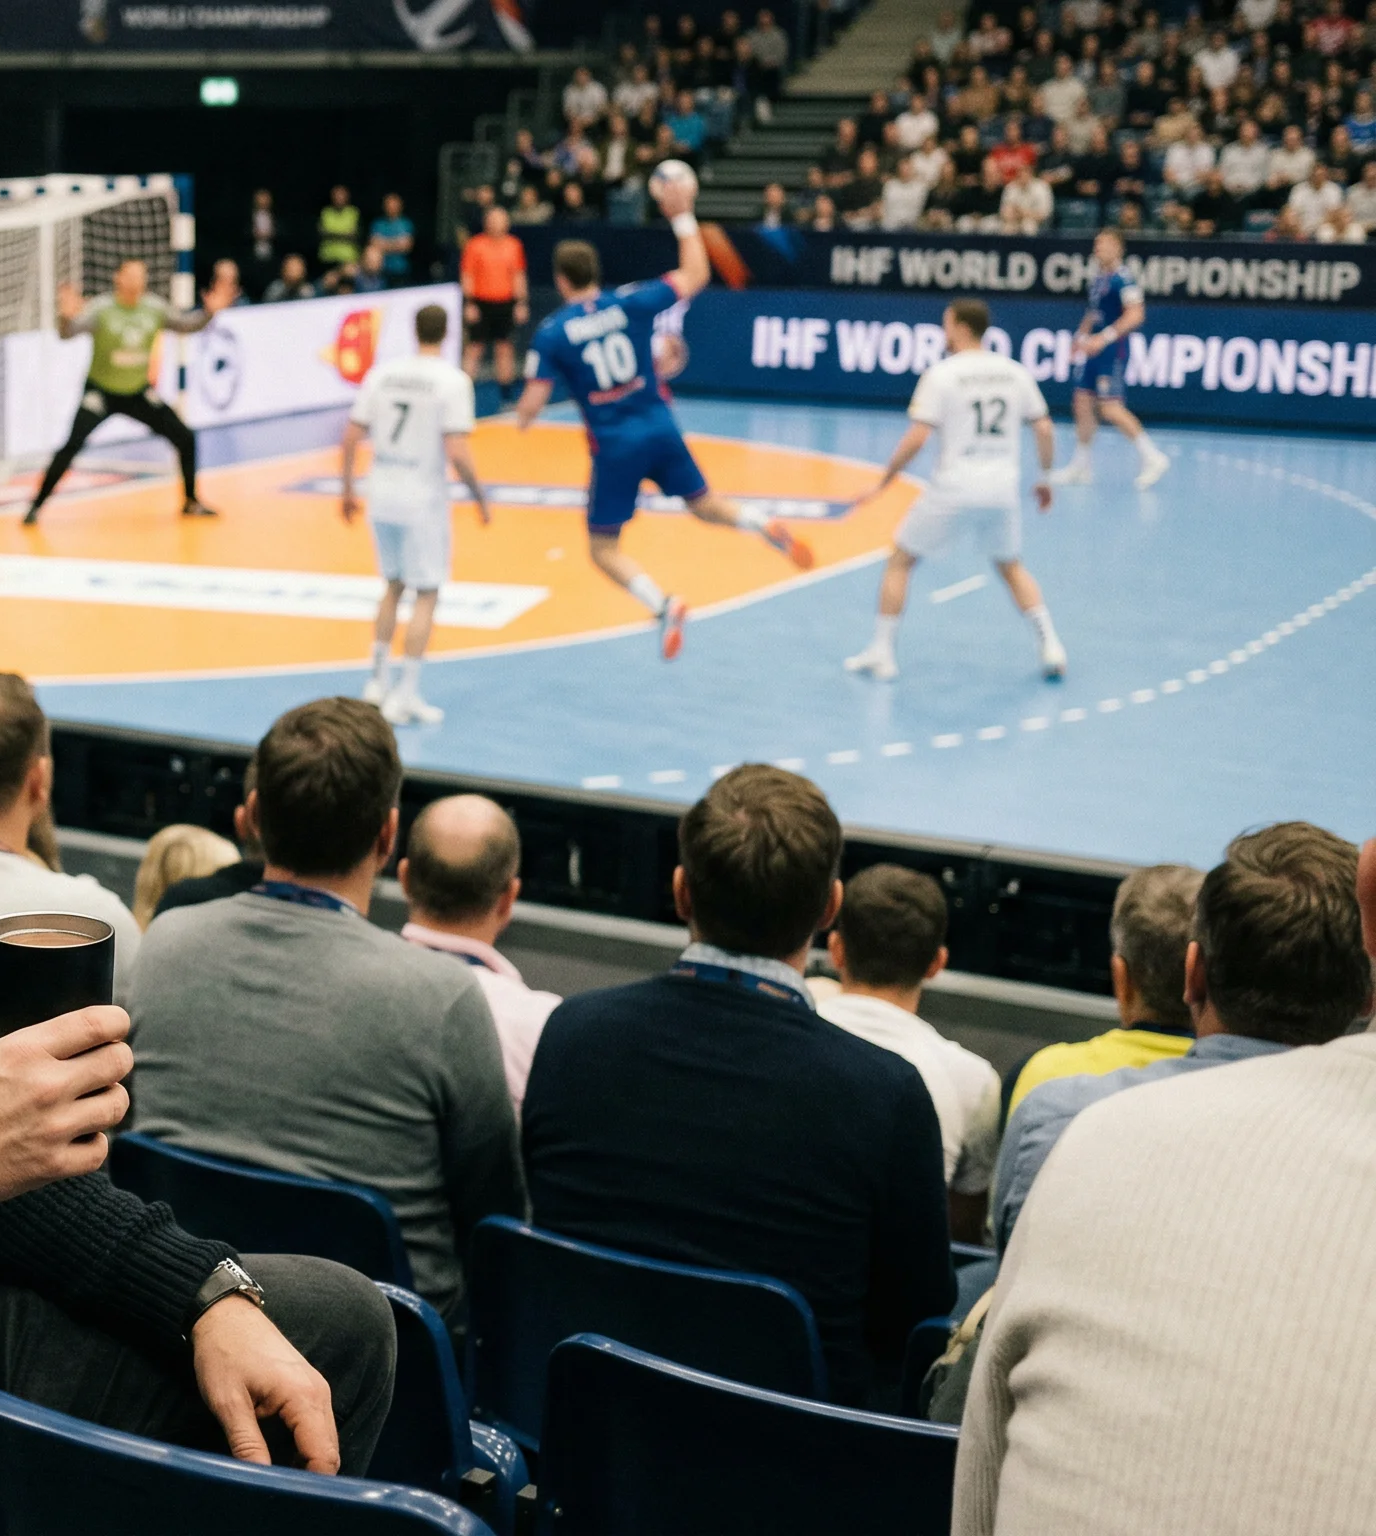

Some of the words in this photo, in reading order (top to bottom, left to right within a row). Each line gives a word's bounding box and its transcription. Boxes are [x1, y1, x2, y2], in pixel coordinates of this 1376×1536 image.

[829, 245, 894, 285] IHF
[898, 248, 1037, 291] WORLD
[1042, 252, 1362, 301] CHMPIONSHIP
[581, 331, 638, 391] 10
[751, 315, 830, 370] IHF
[391, 401, 410, 443] 7
[972, 396, 1007, 436] 12
